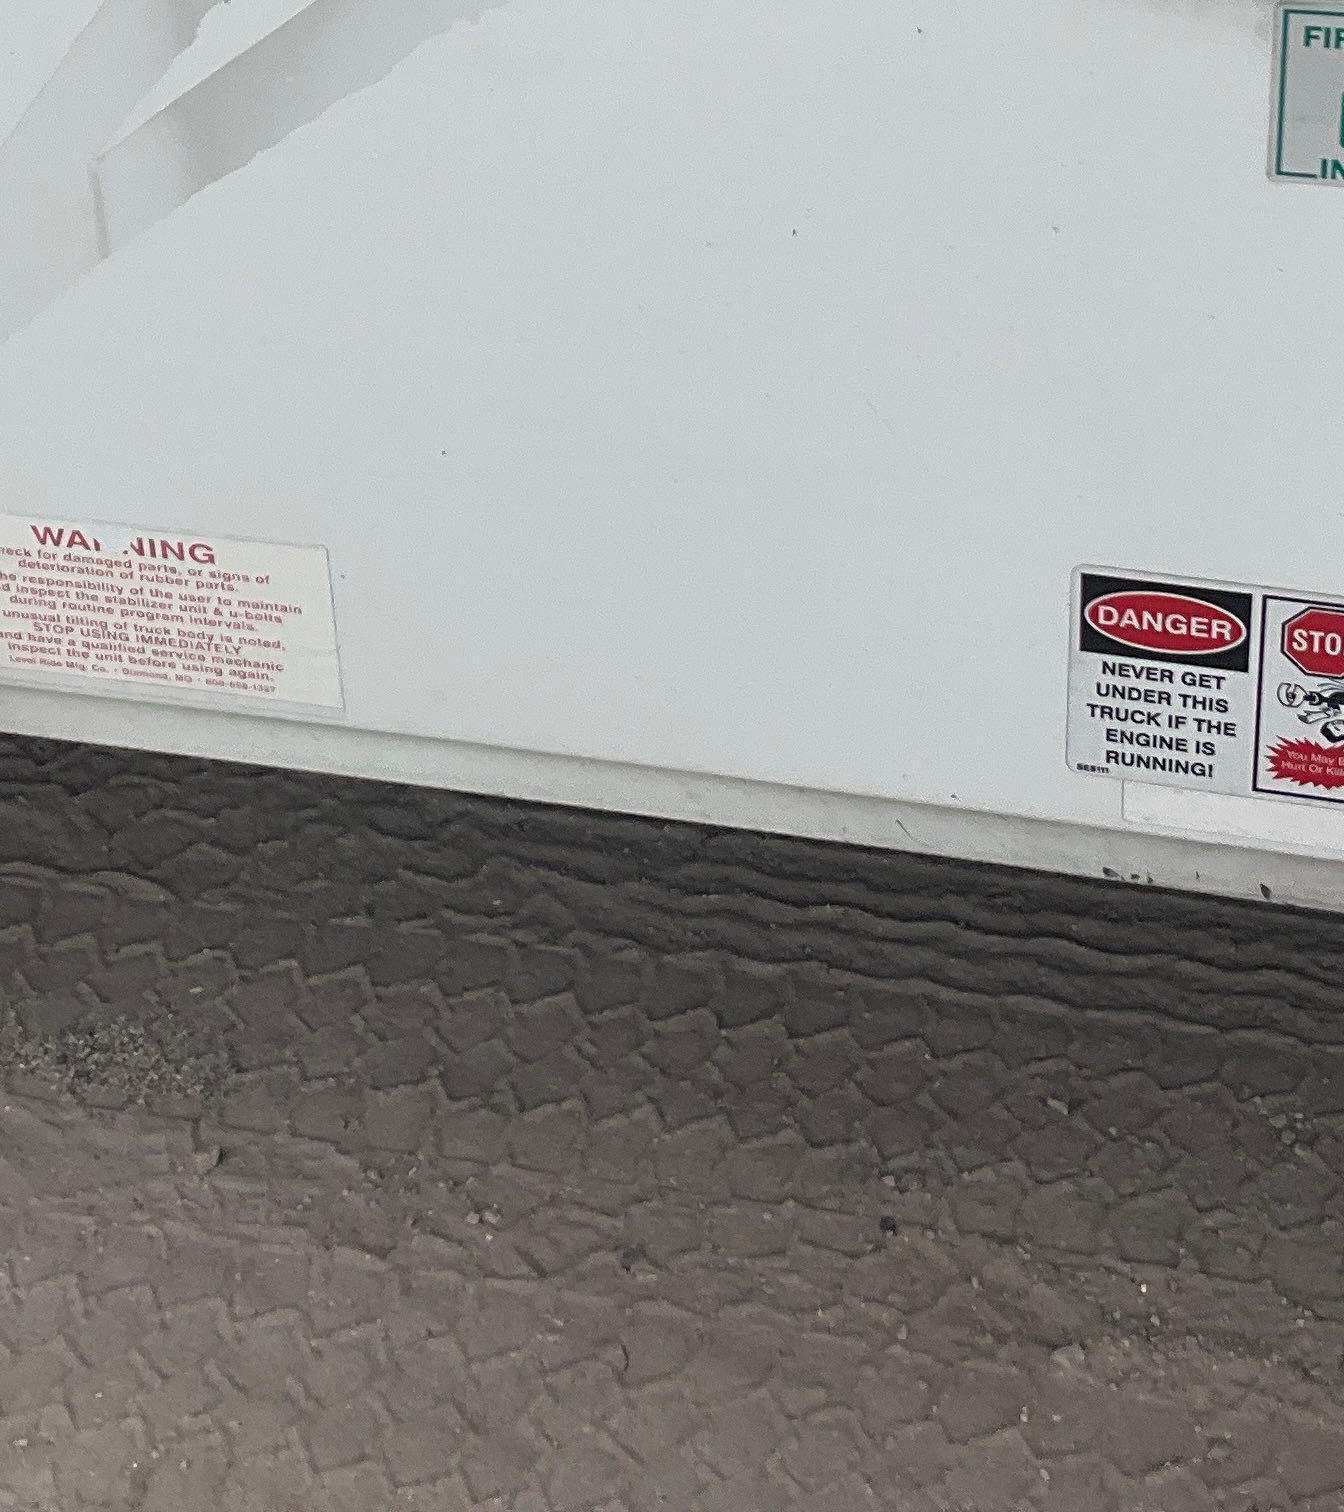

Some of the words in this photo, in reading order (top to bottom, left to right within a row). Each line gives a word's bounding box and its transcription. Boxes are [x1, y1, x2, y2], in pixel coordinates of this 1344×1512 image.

[30, 525, 216, 564] WANING
[18, 559, 113, 577] deterioration
[120, 570, 134, 580] of
[140, 574, 190, 586] rubber
[38, 549, 57, 560] for
[63, 553, 132, 569] damaged
[188, 568, 202, 577] or
[209, 569, 250, 582] signs
[256, 575, 270, 584] of
[9, 595, 56, 610] during
[62, 601, 115, 614] routine
[121, 608, 184, 623] program
[16, 584, 70, 599] inspect
[76, 590, 99, 602] the
[105, 595, 173, 610] stabilizer
[179, 604, 207, 615] unit
[213, 607, 223, 617] &
[229, 609, 283, 624] u-bolts
[23, 575, 123, 595] responsibility
[130, 586, 144, 595] of
[149, 588, 173, 599] the
[178, 593, 212, 603] user
[217, 596, 232, 606] to
[238, 599, 303, 615] maintain
[2, 609, 61, 622] unusual
[66, 614, 108, 630] tilting
[113, 622, 127, 630] of
[133, 623, 171, 635] truck
[177, 628, 214, 643] body
[220, 633, 233, 643] is
[33, 621, 74, 635] STOP
[80, 627, 130, 642] USING
[136, 634, 241, 655] IMMEDIATELY
[1097, 605, 1232, 641] DANGER
[8, 641, 61, 656] inspect
[66, 648, 89, 659] the
[95, 651, 123, 663] unit
[128, 655, 176, 669] before
[182, 663, 223, 676] using
[27, 633, 62, 645] have
[67, 638, 76, 646] a
[81, 640, 145, 654] qualified
[151, 649, 206, 662] service
[211, 655, 284, 672] mechanic
[1102, 661, 1174, 683] NEVER
[1181, 671, 1226, 689] GET
[1096, 682, 1172, 706] UNDER
[1178, 693, 1229, 713] THIS
[1086, 703, 1161, 726] TRUCK
[1168, 715, 1187, 730] IF
[1193, 717, 1237, 738] THE
[1106, 728, 1188, 752] ENGINE
[1195, 740, 1216, 756] IS
[1106, 750, 1214, 778] RUNNING!
